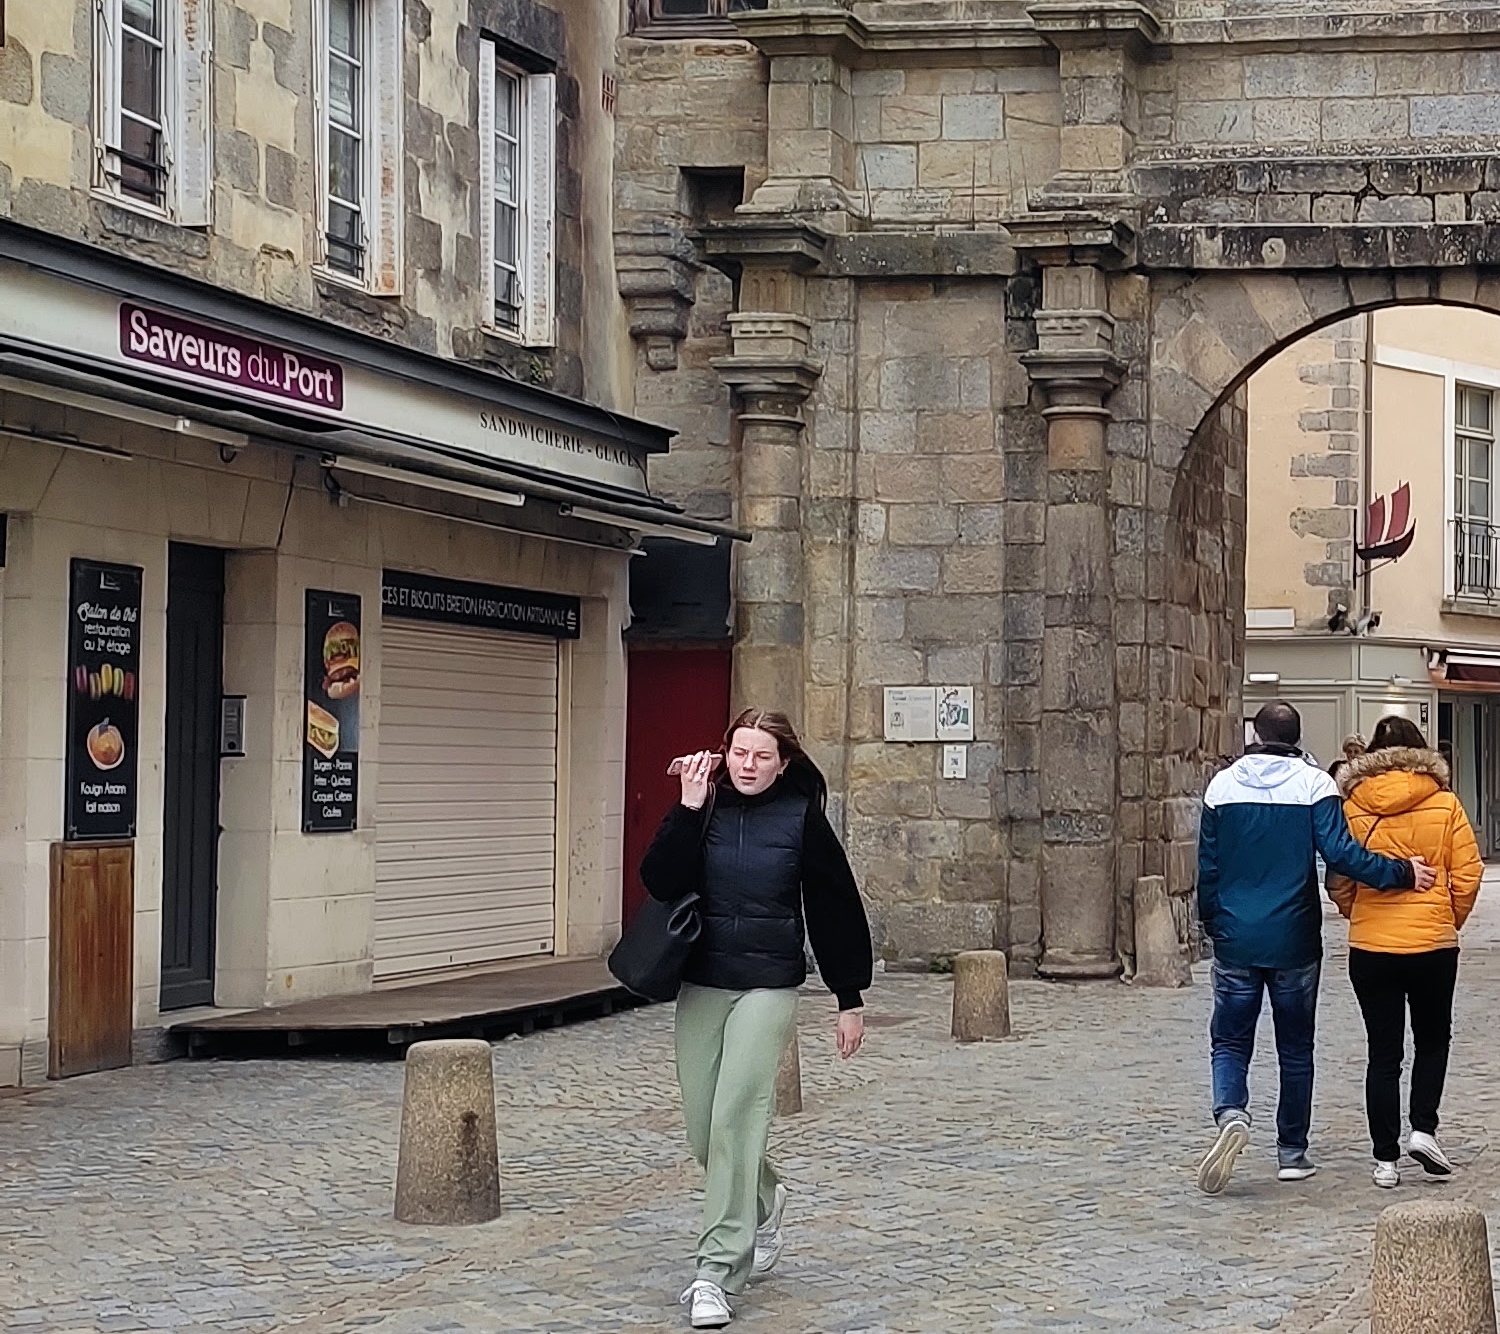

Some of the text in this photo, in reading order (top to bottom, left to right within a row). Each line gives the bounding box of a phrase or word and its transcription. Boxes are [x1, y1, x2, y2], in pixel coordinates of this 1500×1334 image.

[130, 309, 335, 403] Saveurs du Port
[480, 411, 584, 454] SANDWICHERIE
[399, 587, 409, 607] ET
[410, 589, 446, 612] BISCUITS
[446, 594, 478, 615] BRETON
[478, 598, 527, 621] FABRICATION
[83, 622, 131, 638] restauration
[83, 639, 95, 651] au
[106, 639, 131, 656] étage
